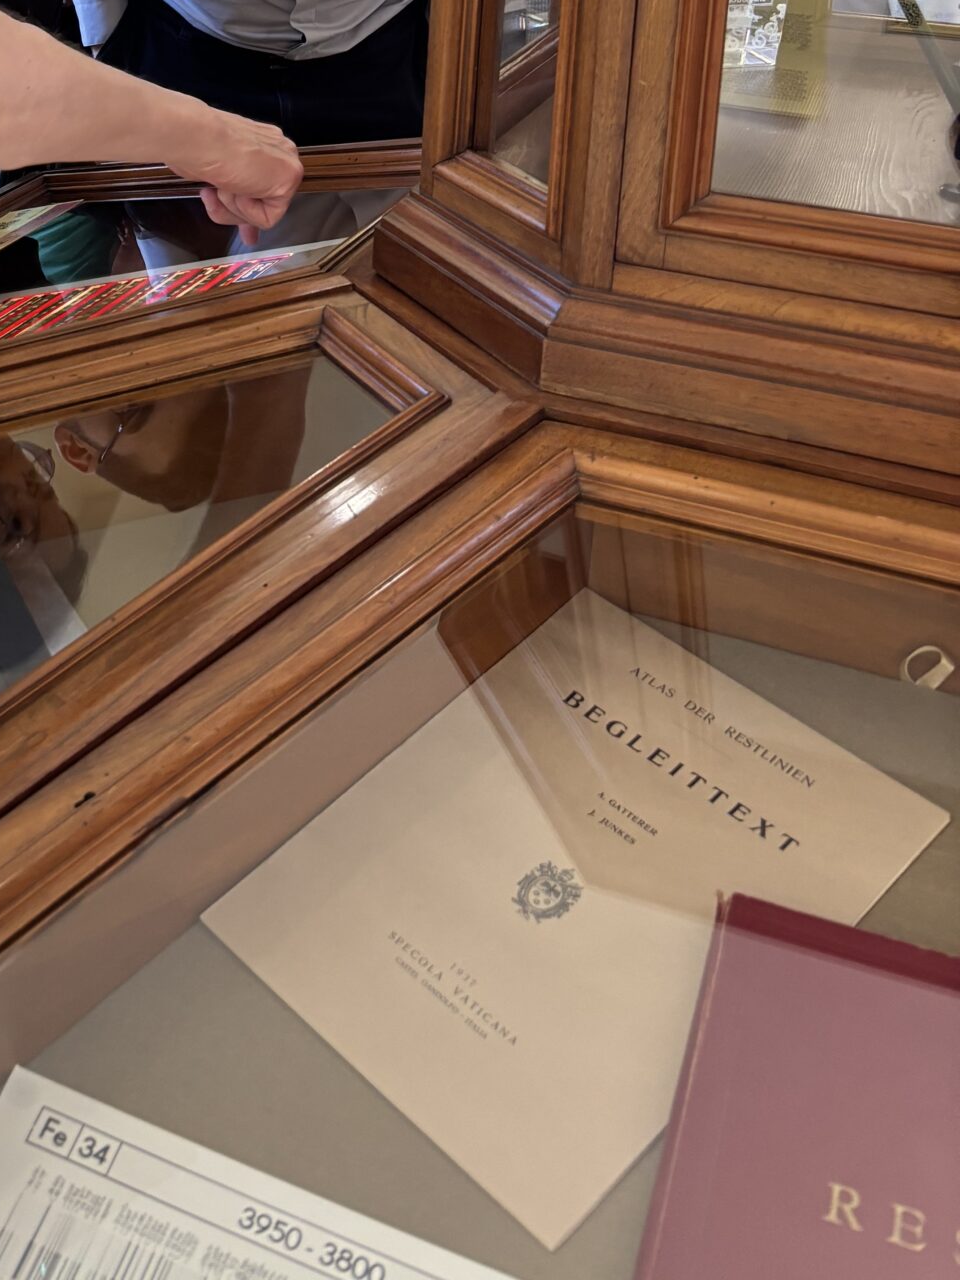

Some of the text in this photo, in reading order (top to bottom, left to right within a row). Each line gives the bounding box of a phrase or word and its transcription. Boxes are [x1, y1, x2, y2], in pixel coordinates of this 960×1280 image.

[630, 667, 815, 788] ATLAS DER RESTLINIEN
[562, 690, 800, 852] BEGLEITTEXT
[599, 817, 636, 845] JUNKES
[608, 799, 658, 836] GATTERER
[388, 931, 518, 1046] SPECOLA VATICANA
[38, 1116, 111, 1165] Fe 34
[238, 1207, 303, 1252] 3950
[319, 1242, 387, 1280] 3800
[822, 1181, 960, 1266] RE
